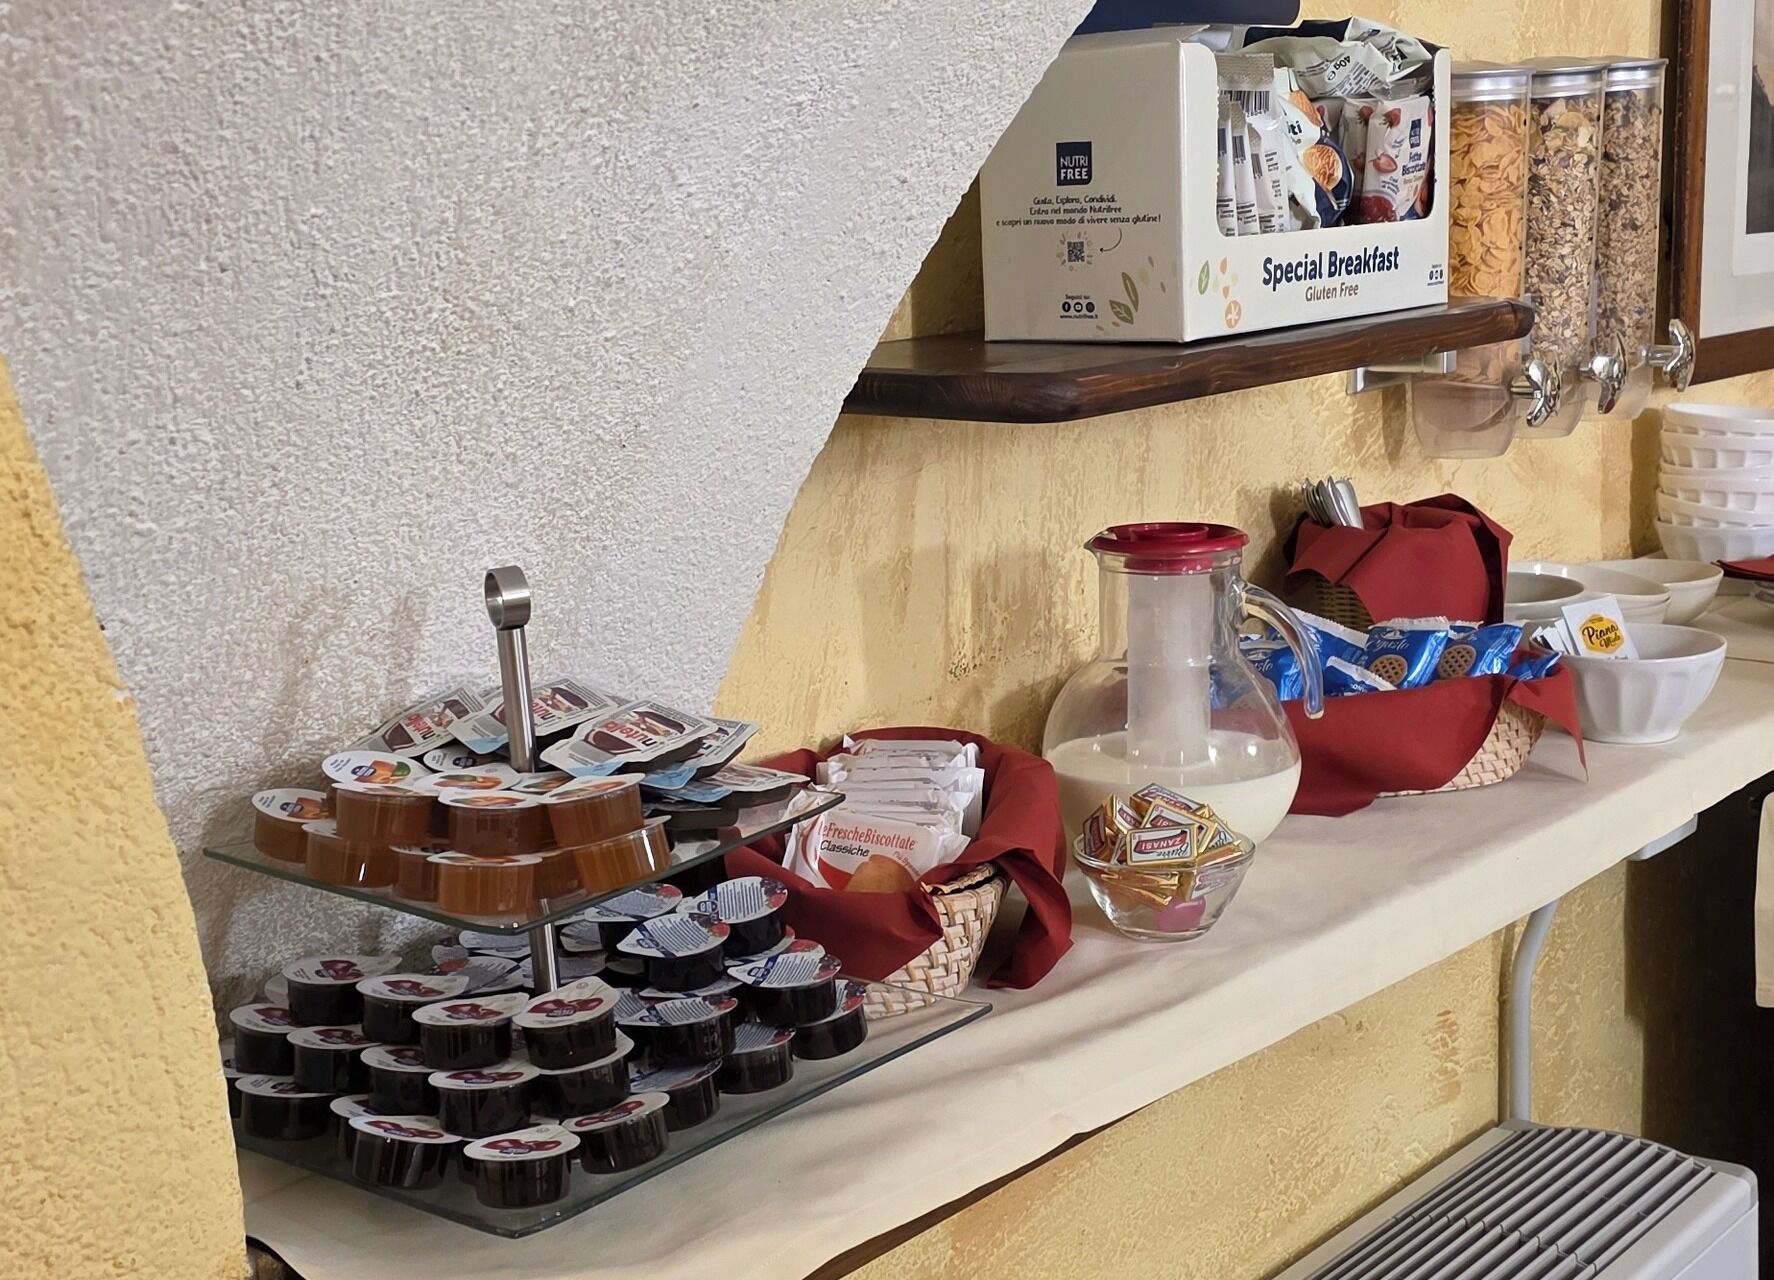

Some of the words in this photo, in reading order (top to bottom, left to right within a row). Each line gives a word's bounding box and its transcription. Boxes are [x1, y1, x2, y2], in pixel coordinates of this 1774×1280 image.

[1060, 155, 1088, 168] NUTRI
[1060, 168, 1088, 181] FREE
[1030, 208, 1049, 216] Entra
[1050, 207, 1061, 215] nel
[1063, 206, 1088, 214] mondo
[1001, 218, 1021, 228] scopri
[1056, 217, 1076, 225] modo
[1077, 216, 1085, 224] di
[1087, 216, 1107, 224] vivere
[1262, 251, 1323, 292] Special
[1328, 245, 1400, 279] Breakfast
[1305, 284, 1337, 302] Gluten
[1339, 282, 1359, 297] Free
[1582, 624, 1619, 645] Piana
[604, 721, 658, 747] nutella
[820, 839, 870, 857] Classiche
[1141, 836, 1182, 850] ZANASI
